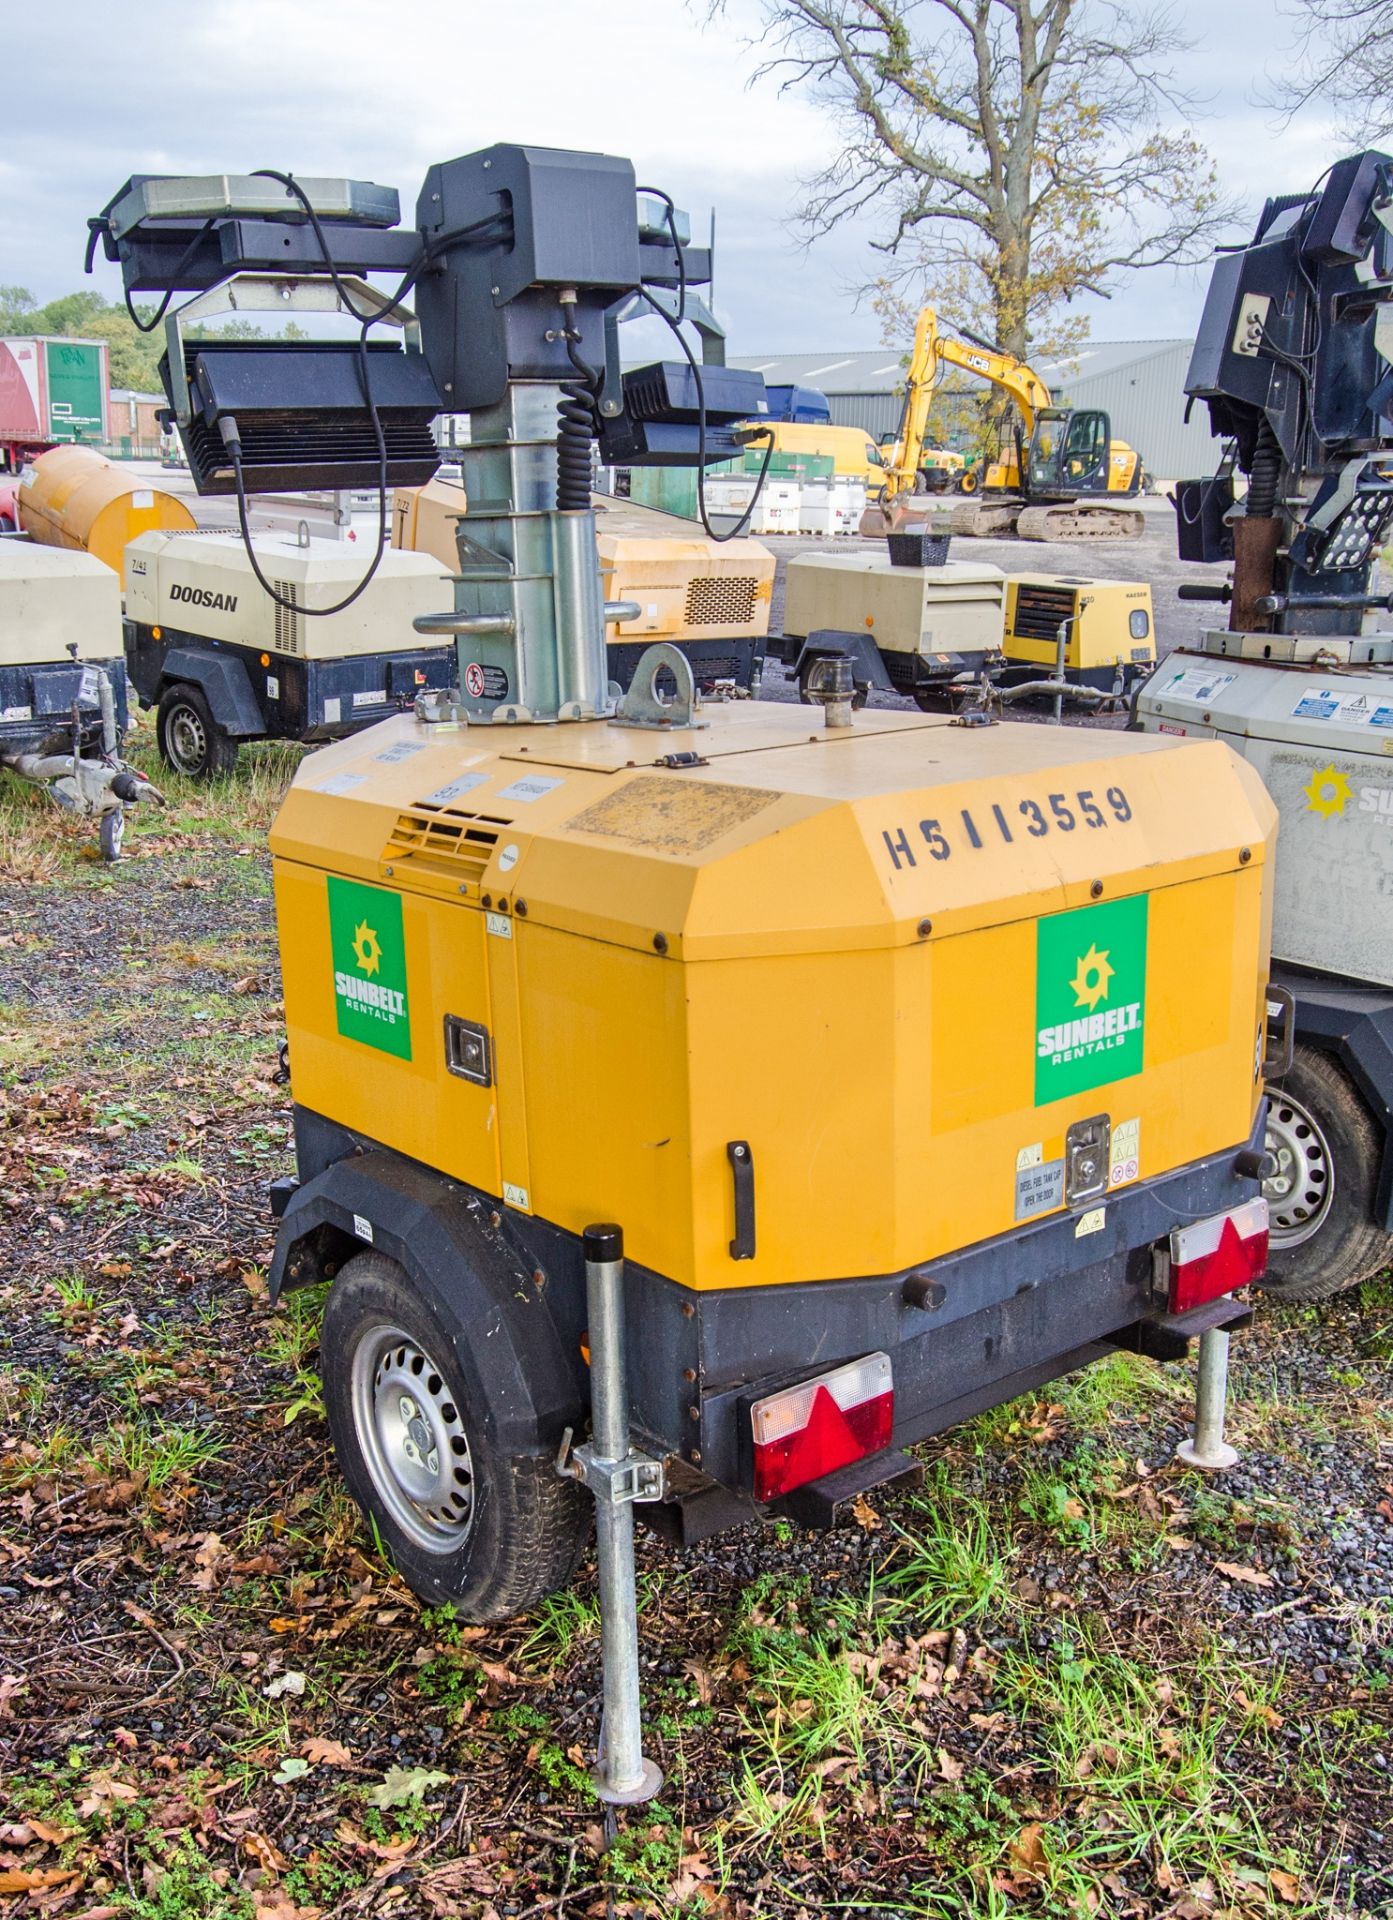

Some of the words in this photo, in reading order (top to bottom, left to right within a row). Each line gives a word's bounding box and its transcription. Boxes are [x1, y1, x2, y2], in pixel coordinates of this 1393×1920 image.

[967, 354, 991, 373] JCB
[169, 583, 238, 613] DOOSAN
[1341, 706, 1371, 714] DANGER
[335, 970, 405, 1017] SUNBELT
[346, 998, 396, 1025] RENTALS
[1037, 1002, 1140, 1057] SUNBELT
[1052, 1034, 1126, 1066] RENTALS
